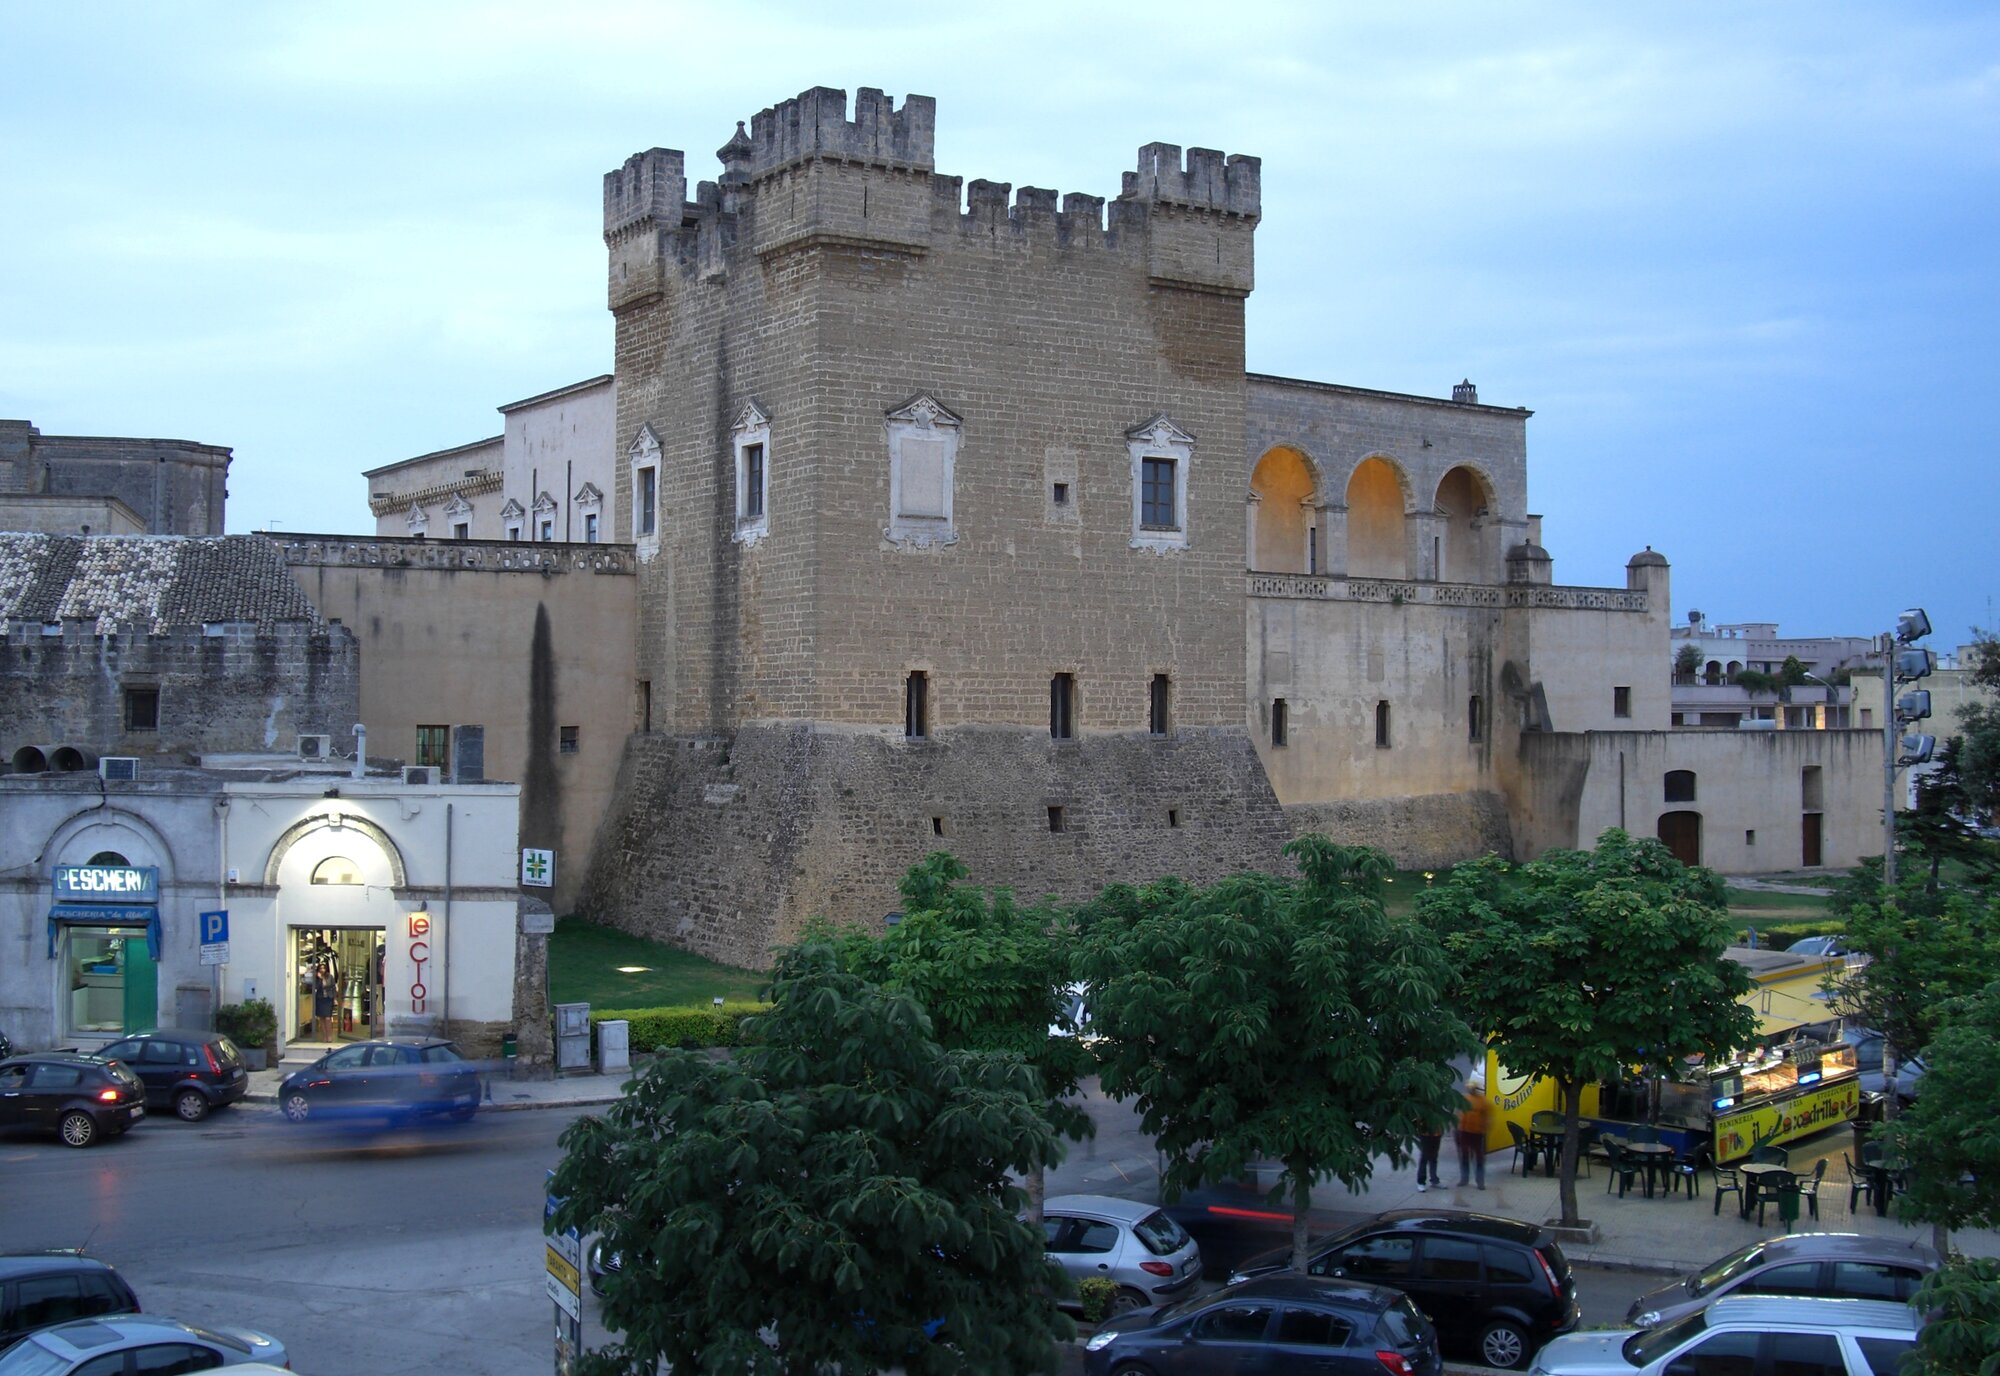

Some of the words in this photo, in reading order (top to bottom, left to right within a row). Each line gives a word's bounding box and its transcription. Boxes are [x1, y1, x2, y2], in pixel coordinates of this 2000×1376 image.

[57, 868, 153, 891] PESCHERIA
[54, 910, 106, 918] PESCHERIA
[207, 915, 223, 941] P
[409, 917, 429, 938] Le
[1720, 1114, 1754, 1130] PANINERIA
